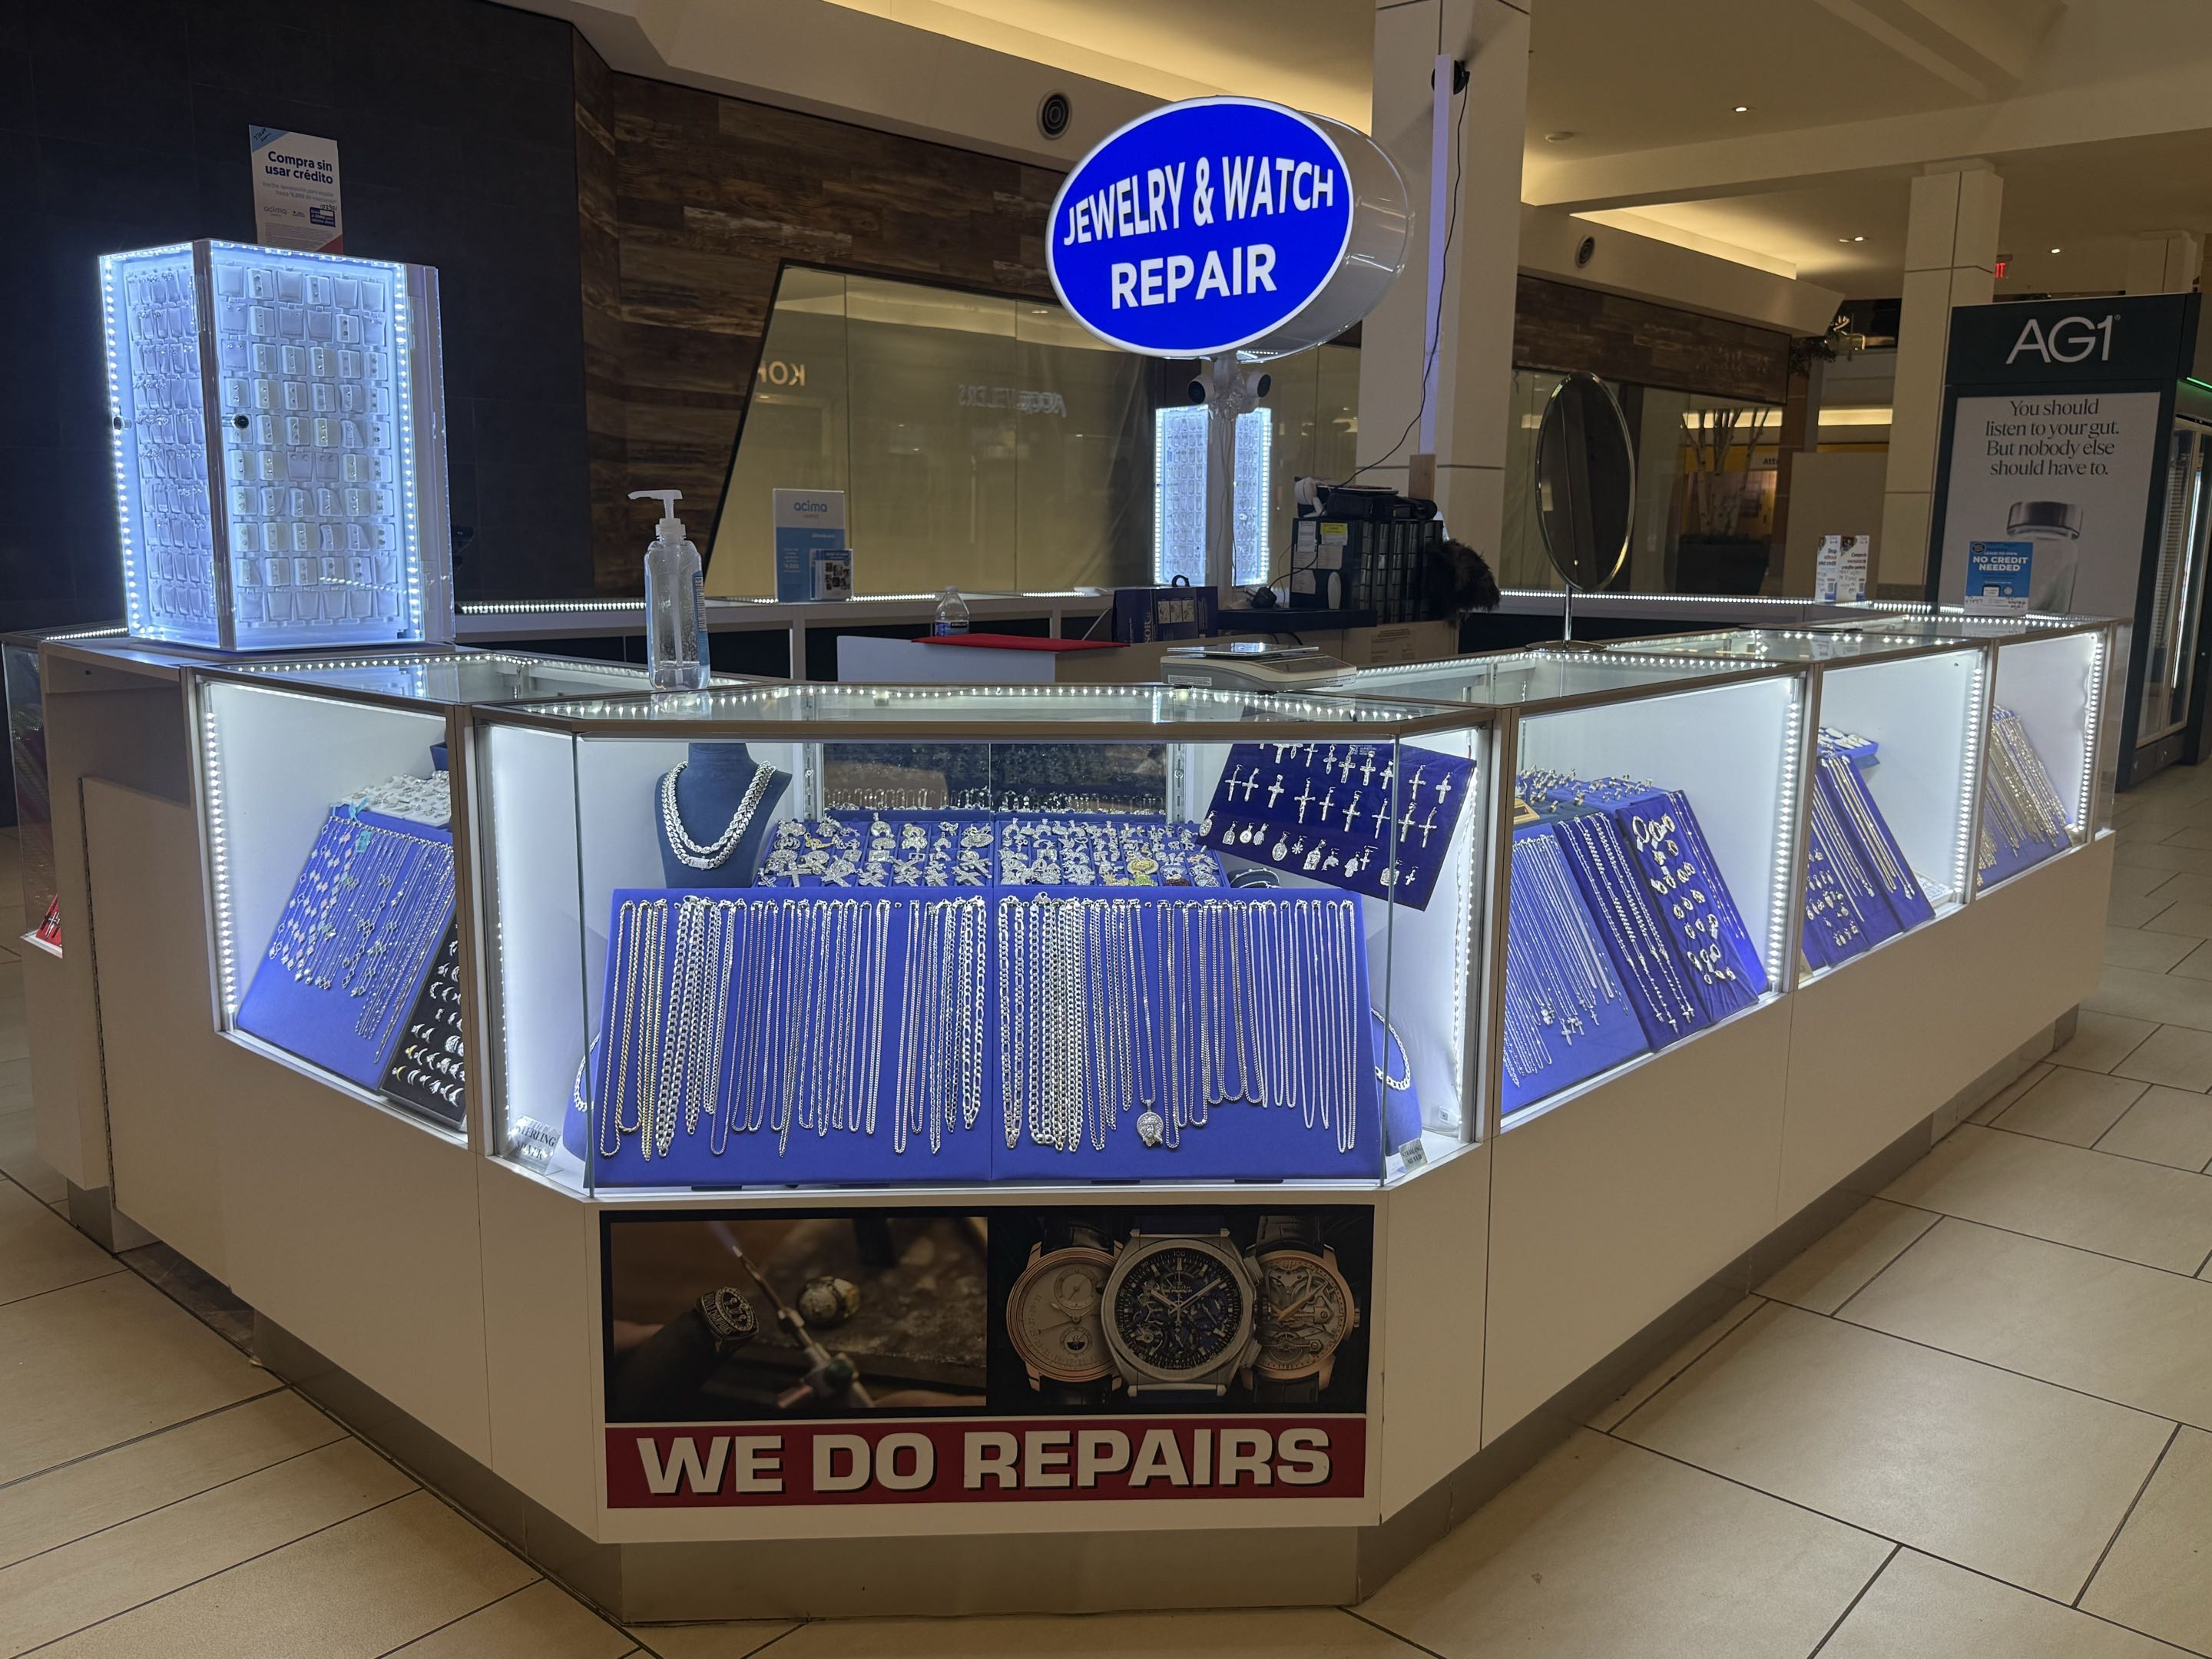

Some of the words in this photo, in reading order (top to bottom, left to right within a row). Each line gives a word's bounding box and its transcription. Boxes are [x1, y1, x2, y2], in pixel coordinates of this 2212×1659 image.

[268, 151, 315, 170] Compra
[317, 160, 333, 172] sin
[265, 164, 291, 177] usar
[293, 169, 333, 184] crédito
[263, 205, 287, 215] acima
[1063, 161, 1186, 246] JEWELRY
[1192, 156, 1215, 227] &
[1221, 155, 1334, 221] WATCH
[1111, 243, 1278, 310] REPAIR
[2005, 315, 2114, 365] AG1
[2009, 400, 2039, 416] You
[2042, 398, 2099, 416] should
[1985, 421, 2027, 436] listen
[2031, 423, 2046, 436] to
[2047, 423, 2088, 439] your
[2088, 422, 2119, 439] gut.
[1986, 441, 2014, 456] But
[2018, 439, 2080, 459] nobody
[2082, 439, 2114, 455] else
[1990, 460, 2043, 476] should
[2048, 459, 2086, 475] have
[2090, 461, 2108, 475] to.
[793, 500, 828, 512] acima
[1972, 555, 1988, 564] NO
[1991, 556, 2028, 565] CREDIT
[635, 1433, 784, 1495] WE
[811, 1431, 937, 1492] DO
[962, 1426, 1333, 1489] REPAIRS
